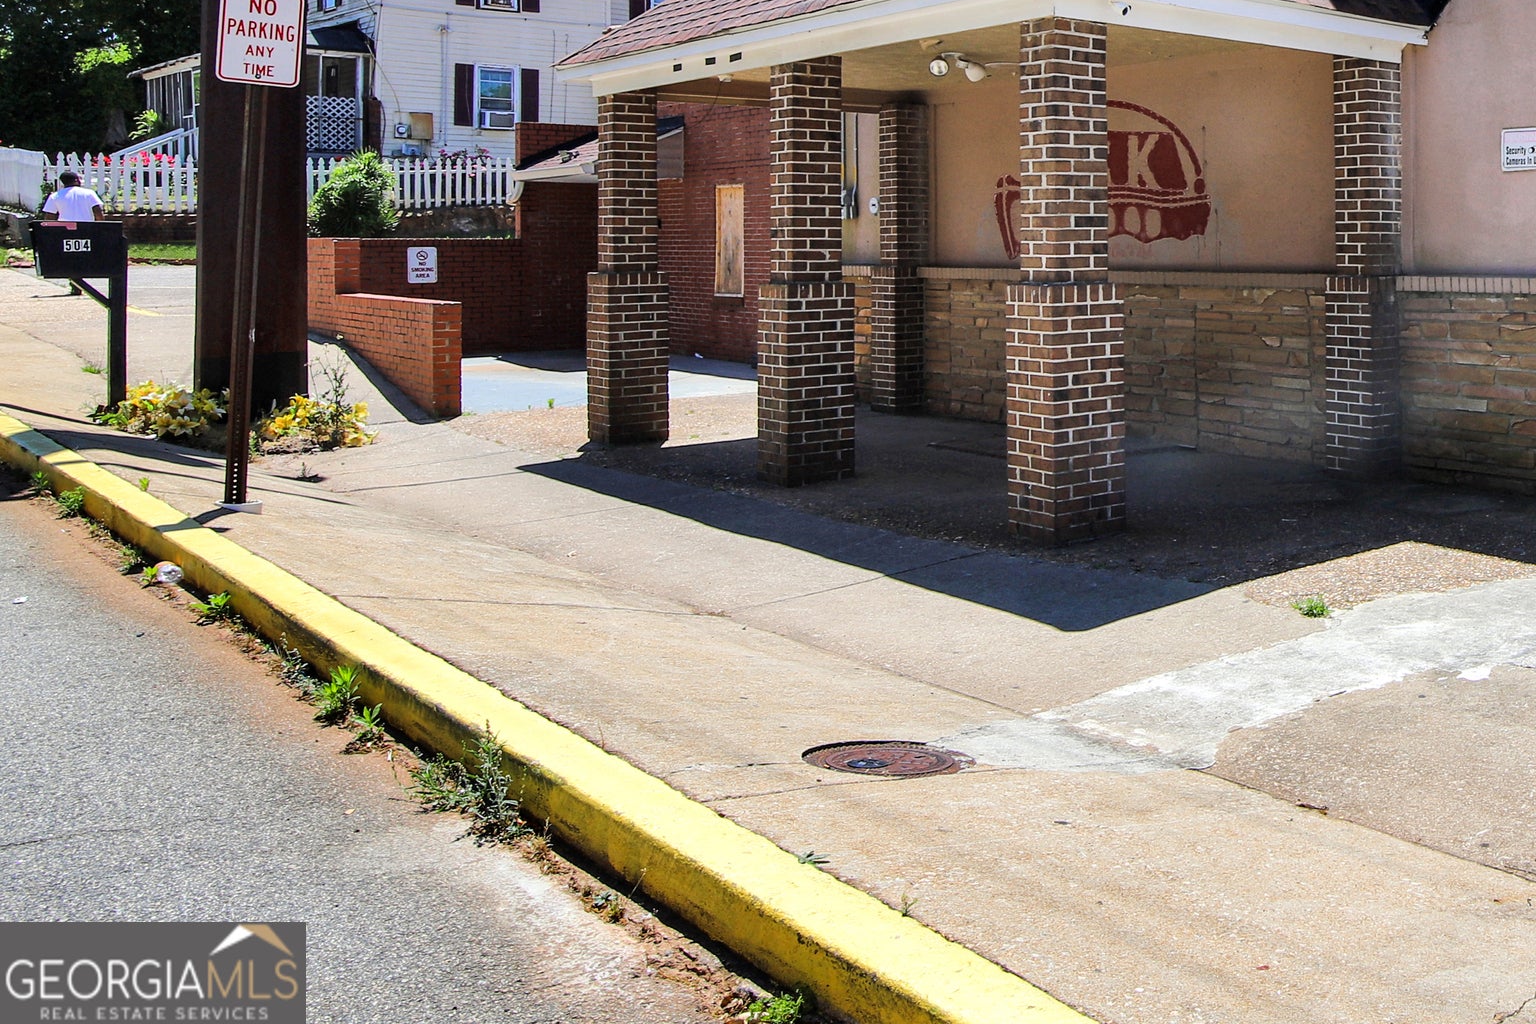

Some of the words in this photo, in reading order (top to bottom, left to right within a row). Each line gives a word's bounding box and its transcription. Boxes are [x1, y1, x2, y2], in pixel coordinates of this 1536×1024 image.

[227, 18, 295, 42] PARKING
[245, 44, 275, 58] ANY
[243, 62, 275, 77] TIME
[1506, 145, 1526, 156] Security
[1506, 156, 1526, 166] Cameras
[65, 240, 90, 251] 504
